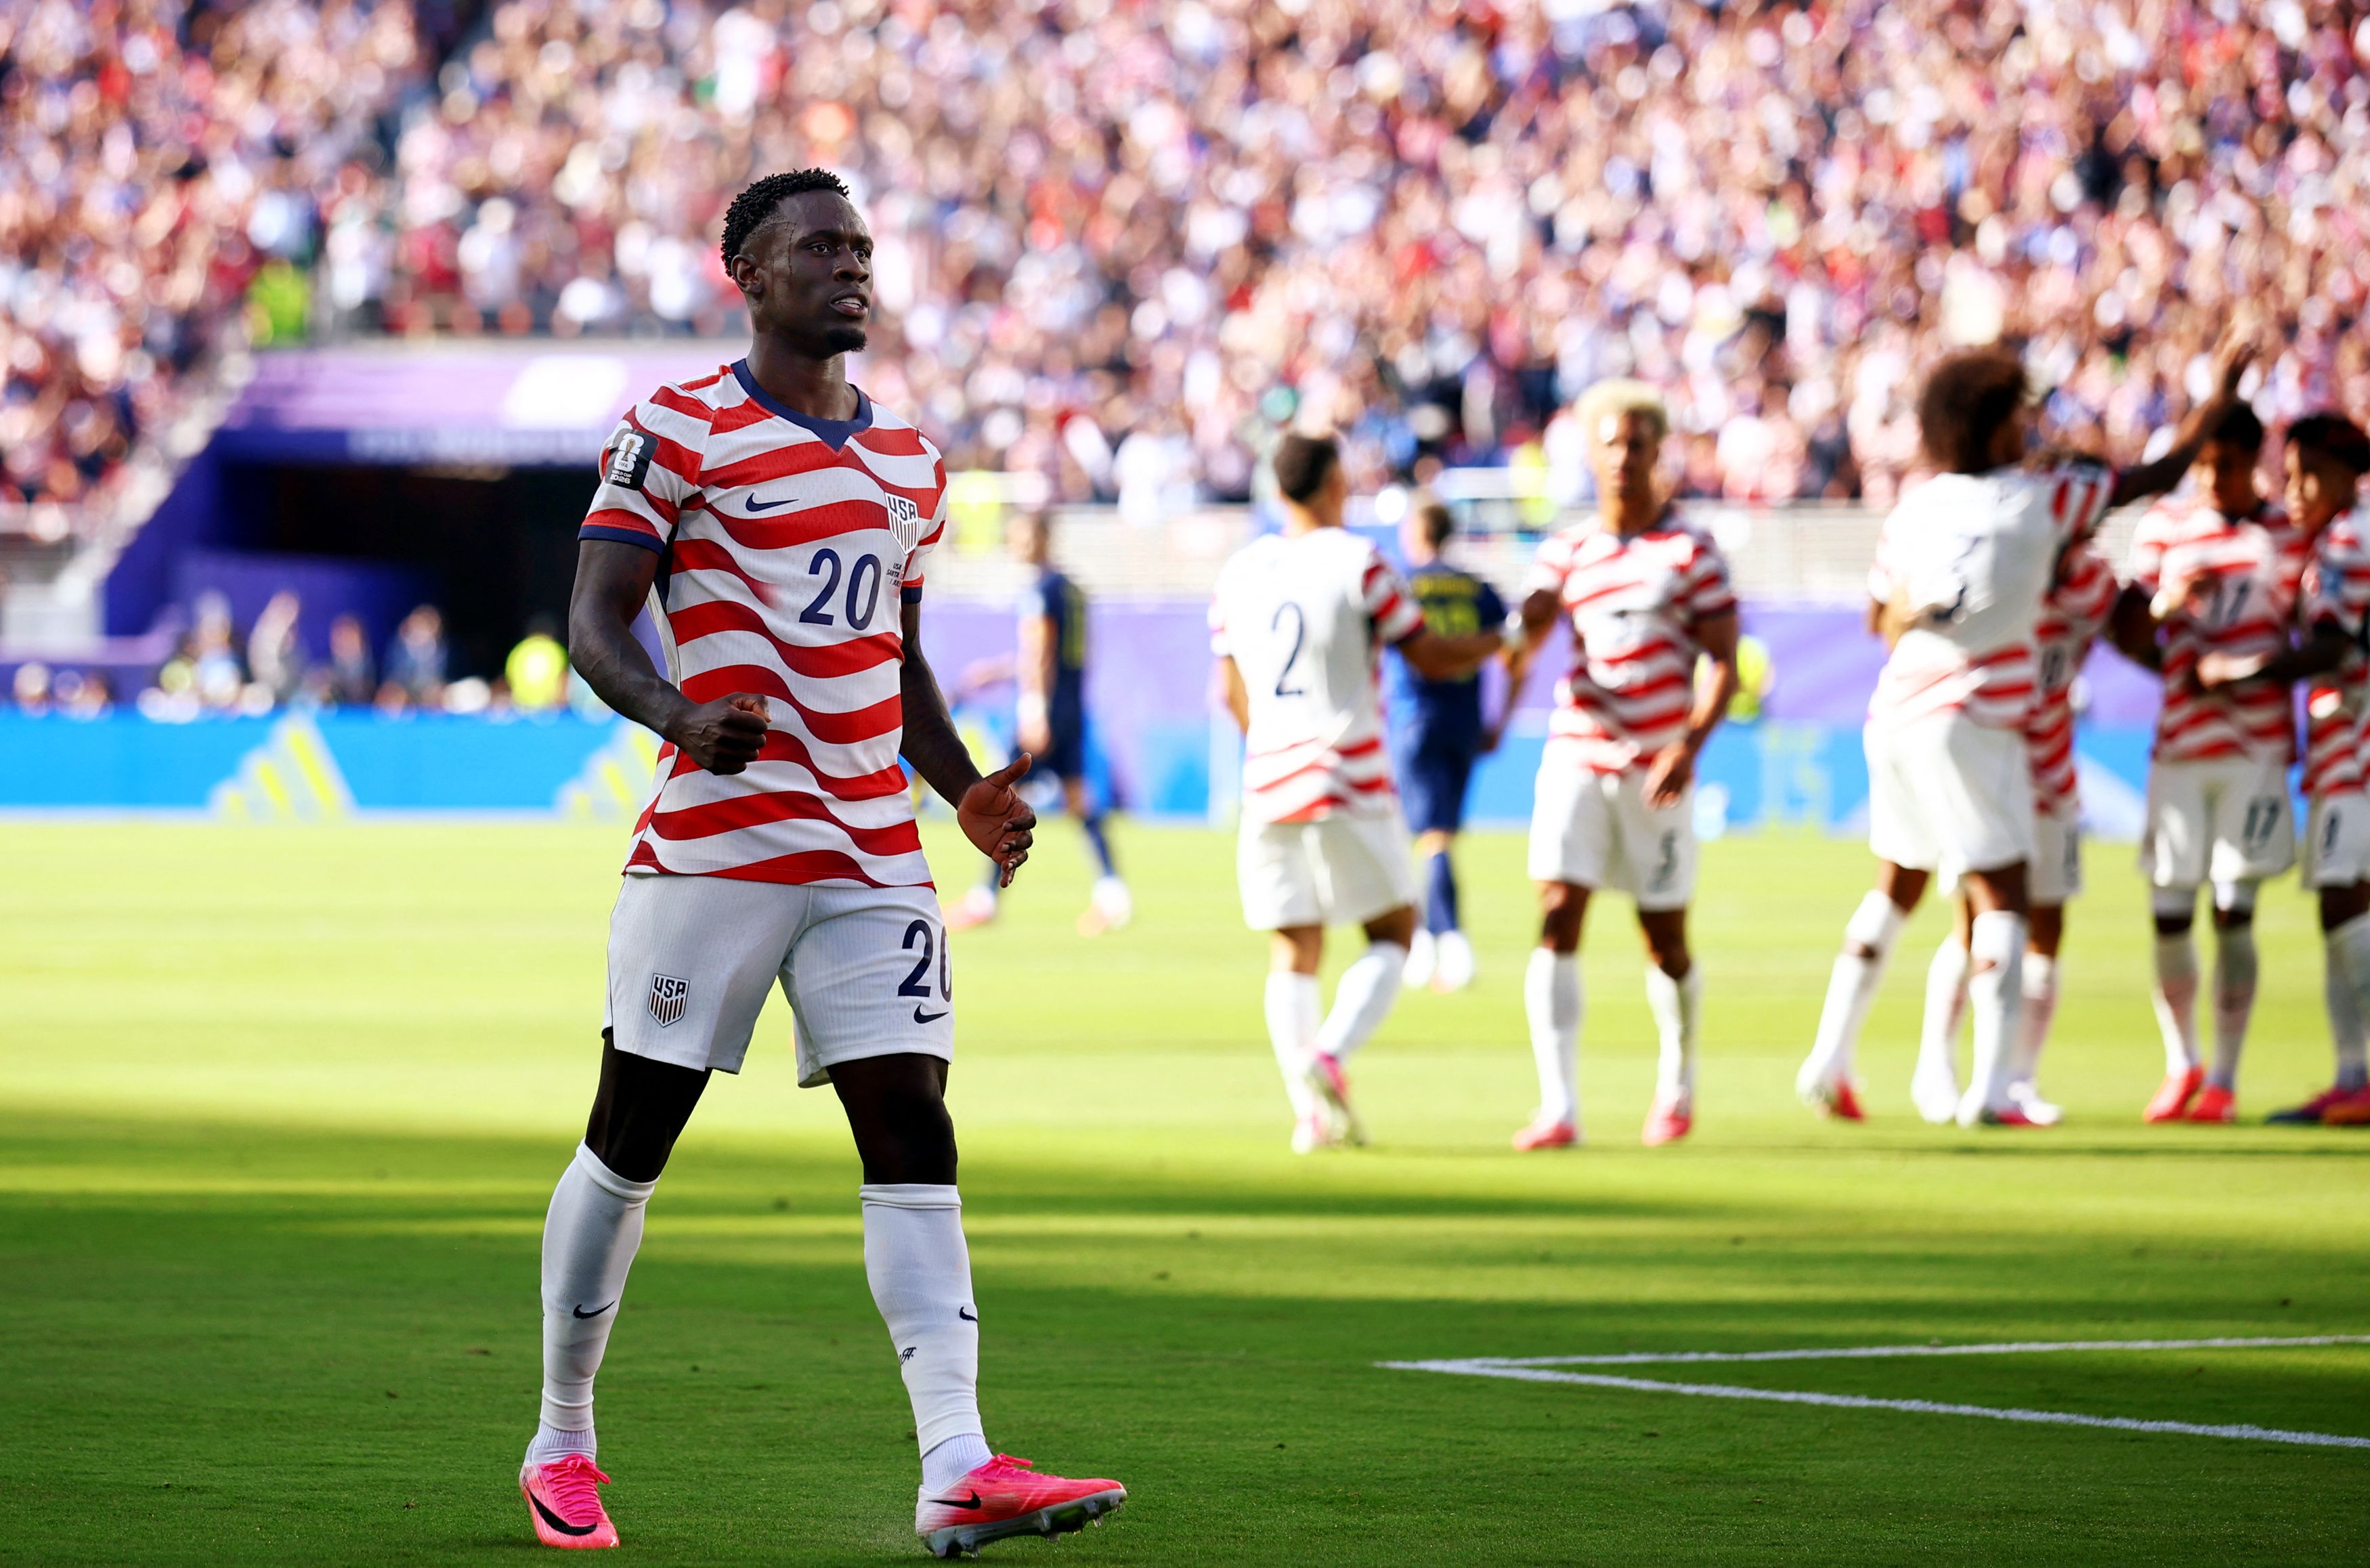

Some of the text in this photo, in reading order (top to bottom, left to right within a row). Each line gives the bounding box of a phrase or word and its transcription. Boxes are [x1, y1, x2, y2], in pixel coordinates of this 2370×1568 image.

[610, 474, 631, 484] 2026
[888, 496, 916, 521] USA
[886, 569, 900, 578] SANTA
[893, 563, 902, 571] USA
[799, 548, 882, 631] 20
[1271, 601, 1304, 697] 2
[897, 919, 952, 1003] 20
[653, 976, 687, 999] USA
